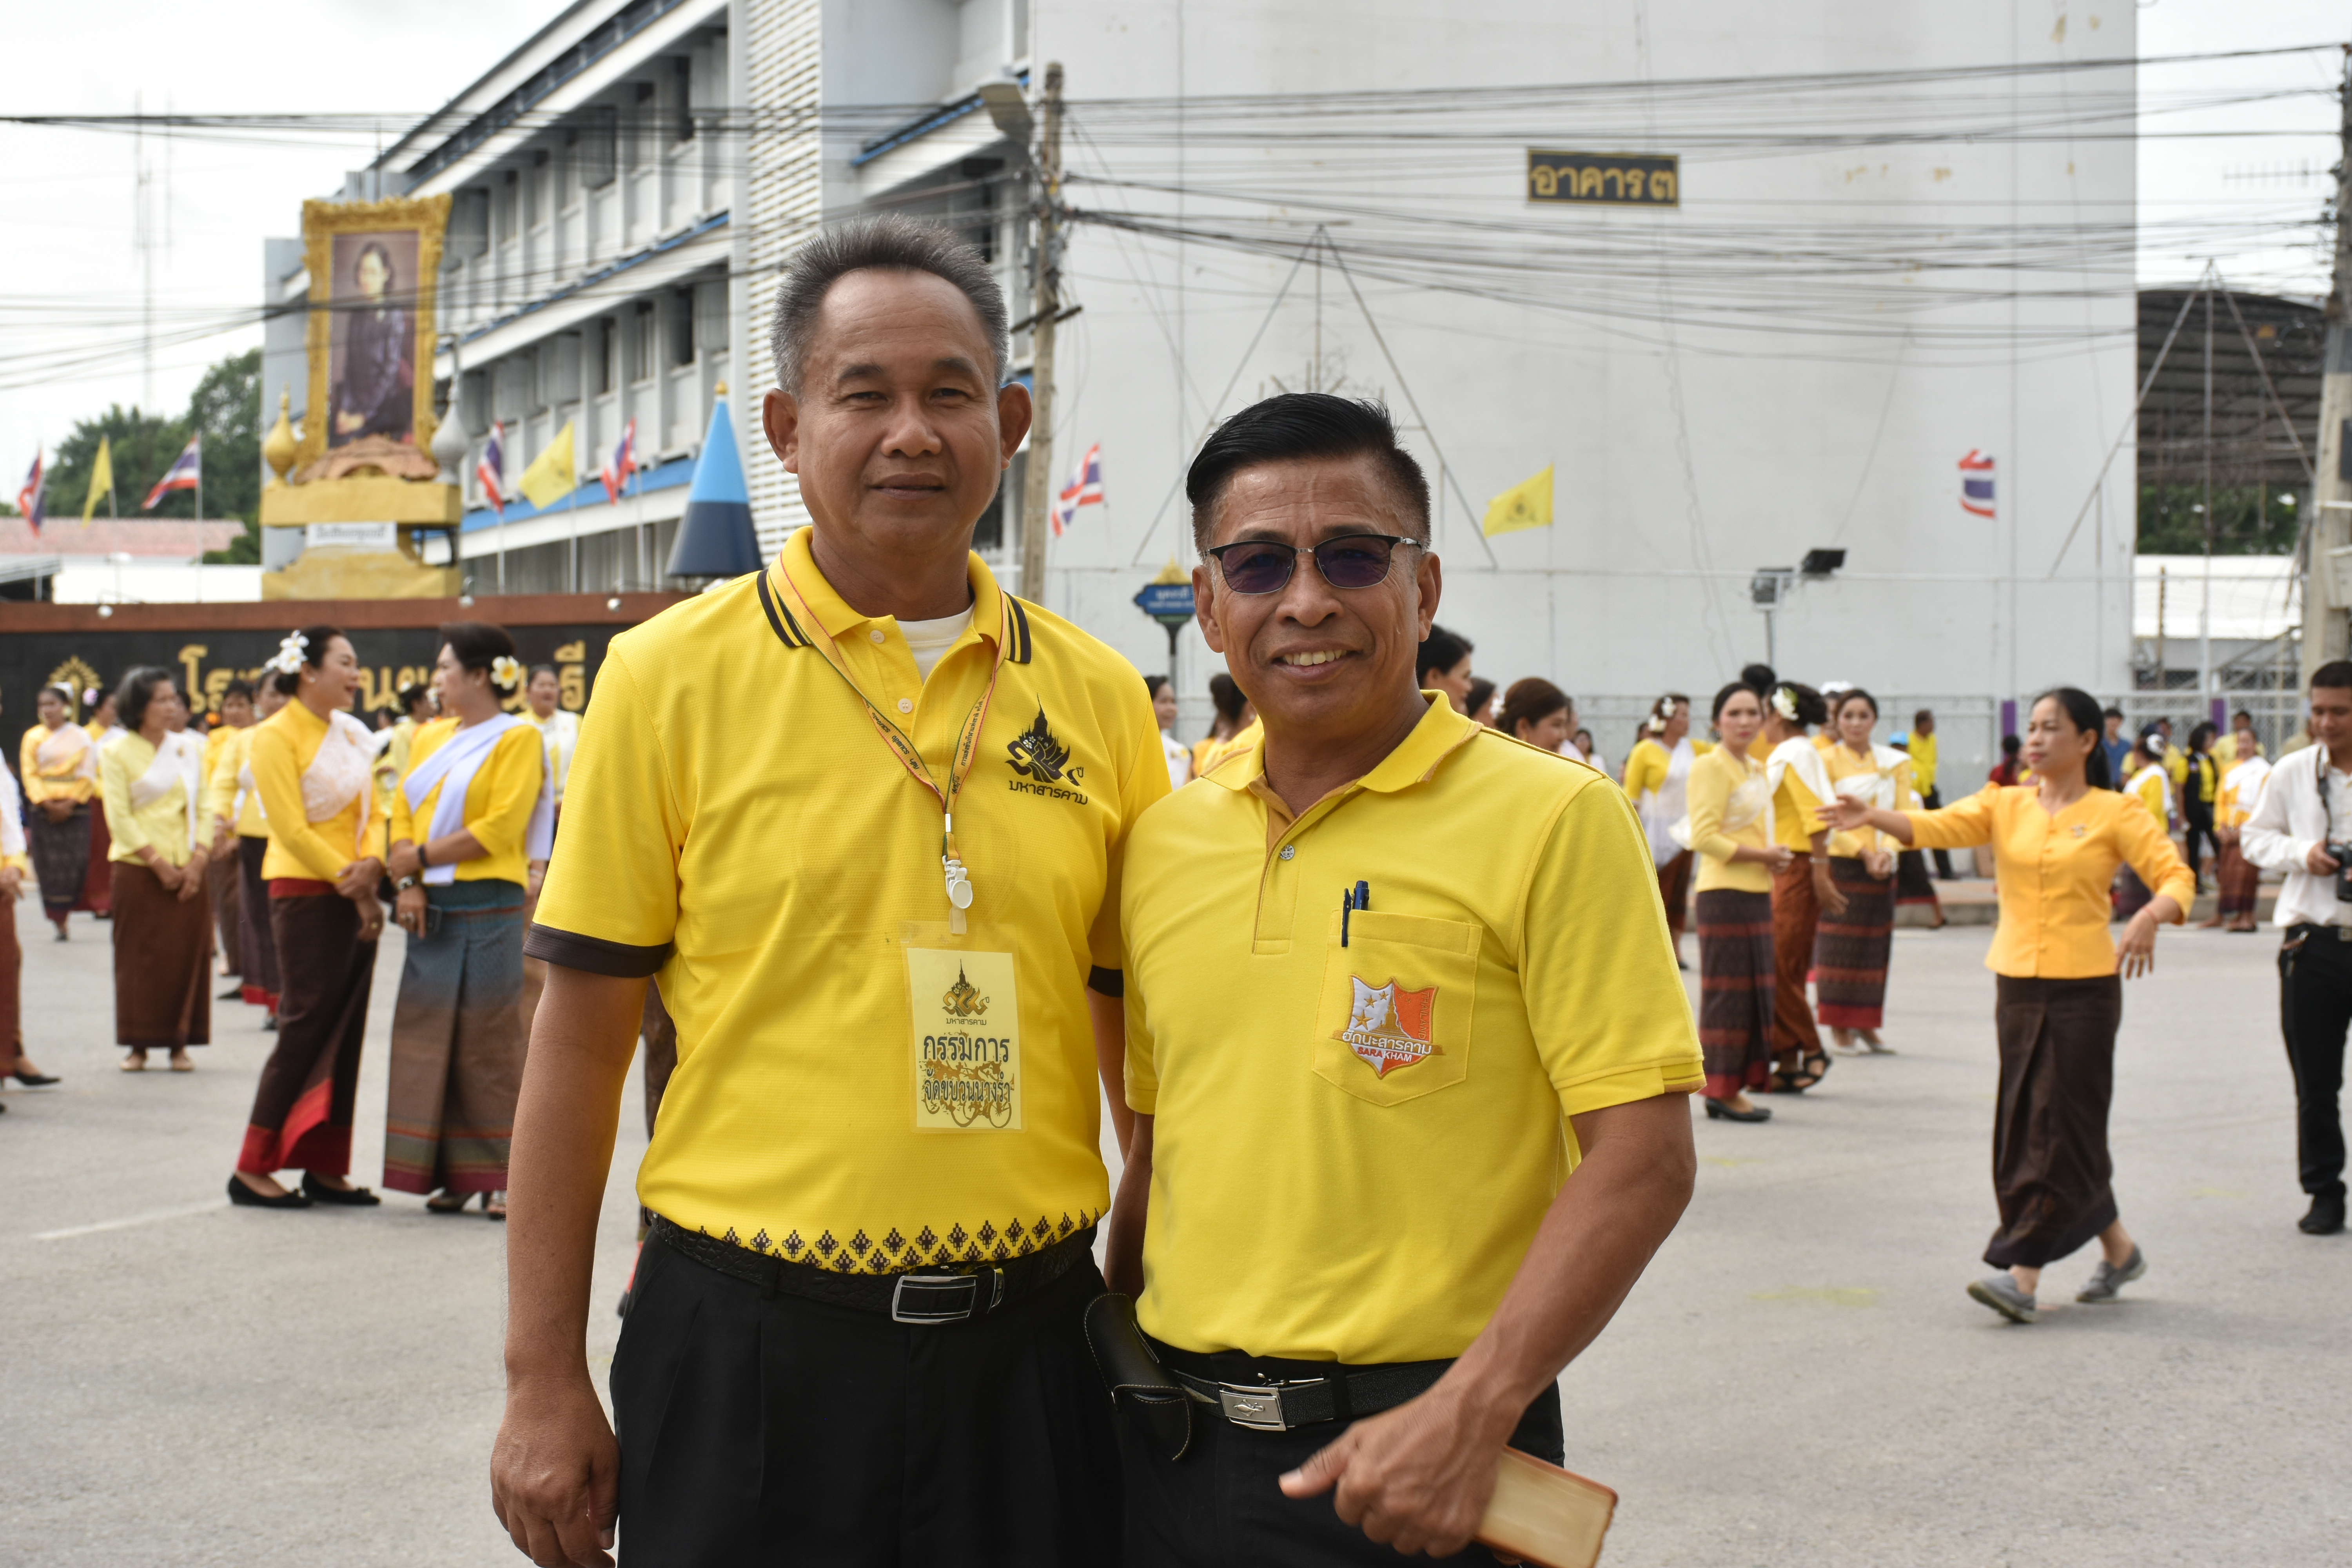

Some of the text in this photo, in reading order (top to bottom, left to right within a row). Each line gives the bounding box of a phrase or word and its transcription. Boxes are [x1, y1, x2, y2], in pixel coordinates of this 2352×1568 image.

[1530, 165, 1646, 200] อาคาร
[1009, 780, 1088, 805] มหาสารคาม
[1418, 992, 1430, 1040] THAILAND
[924, 1036, 1010, 1062] กรรมการ
[924, 1068, 1010, 1102] จัดขบวนนางรำ
